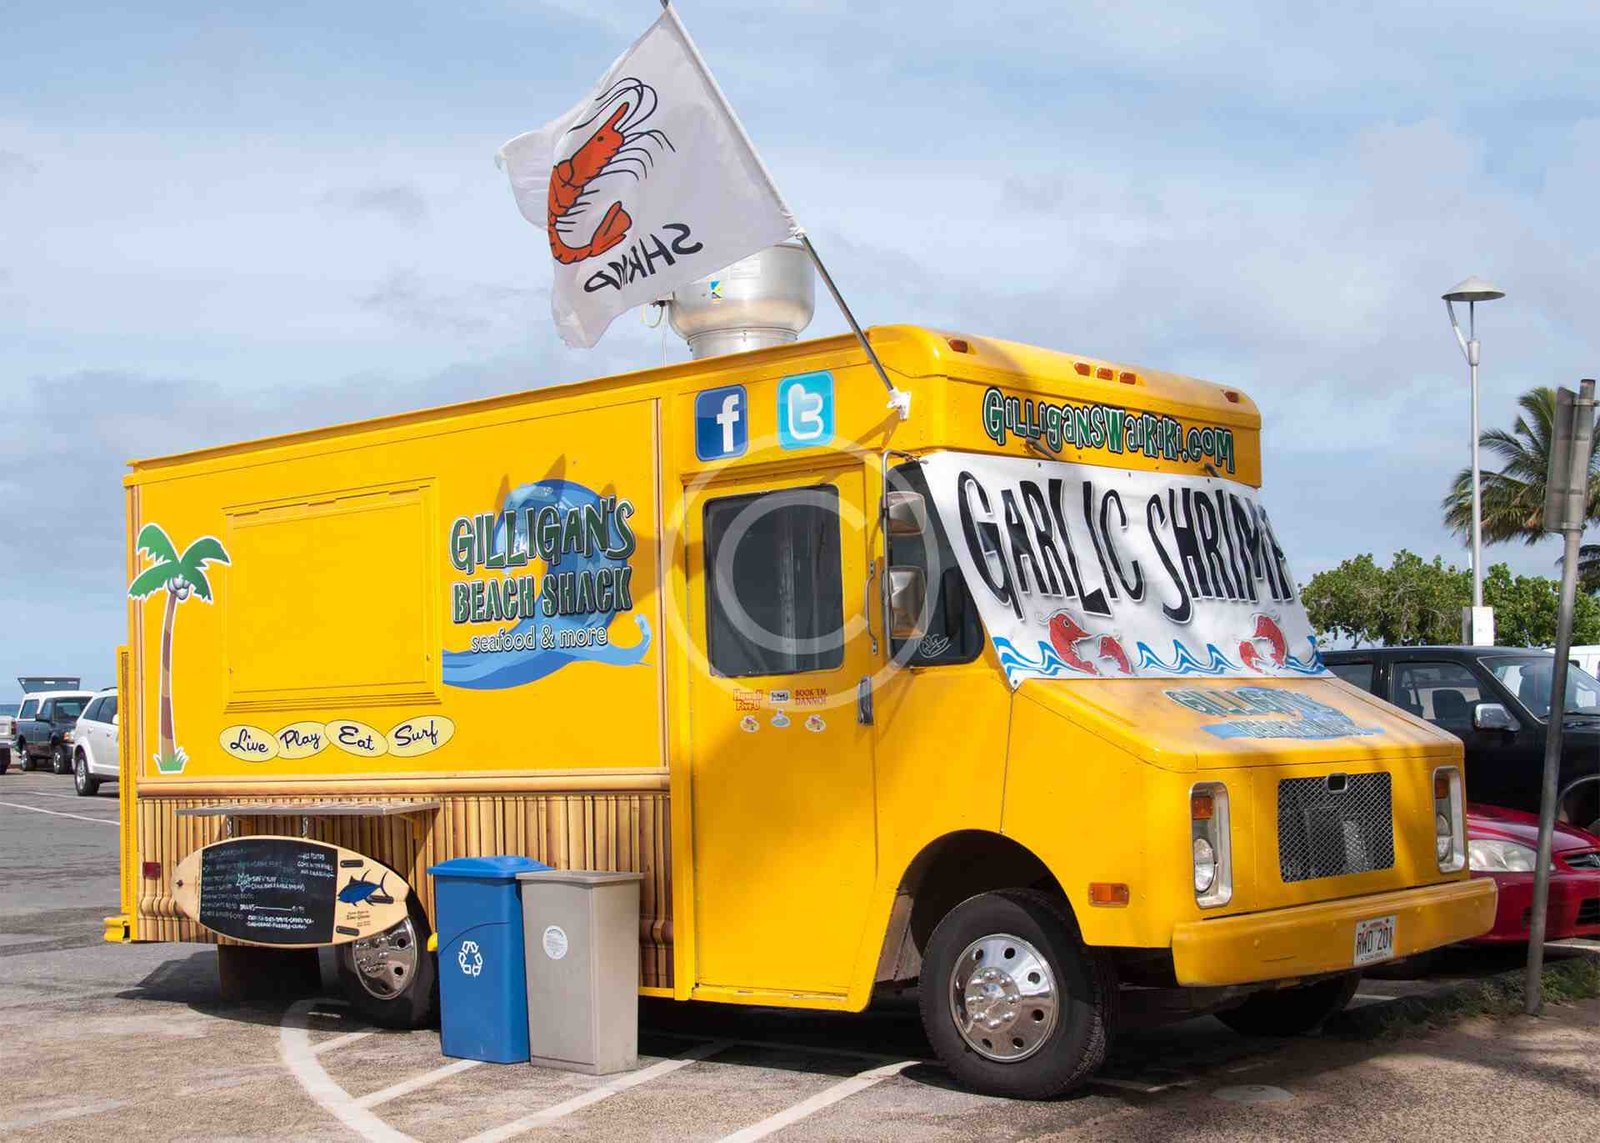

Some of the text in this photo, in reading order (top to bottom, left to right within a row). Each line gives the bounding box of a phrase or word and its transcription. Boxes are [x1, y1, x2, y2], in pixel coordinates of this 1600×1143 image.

[450, 495, 636, 574] GILLIGAN'S
[957, 471, 1146, 620] GARLIC
[453, 566, 633, 624] BEACH SHACK
[471, 625, 608, 652] seafood & more
[229, 720, 439, 753] Live Play Eat Surf
